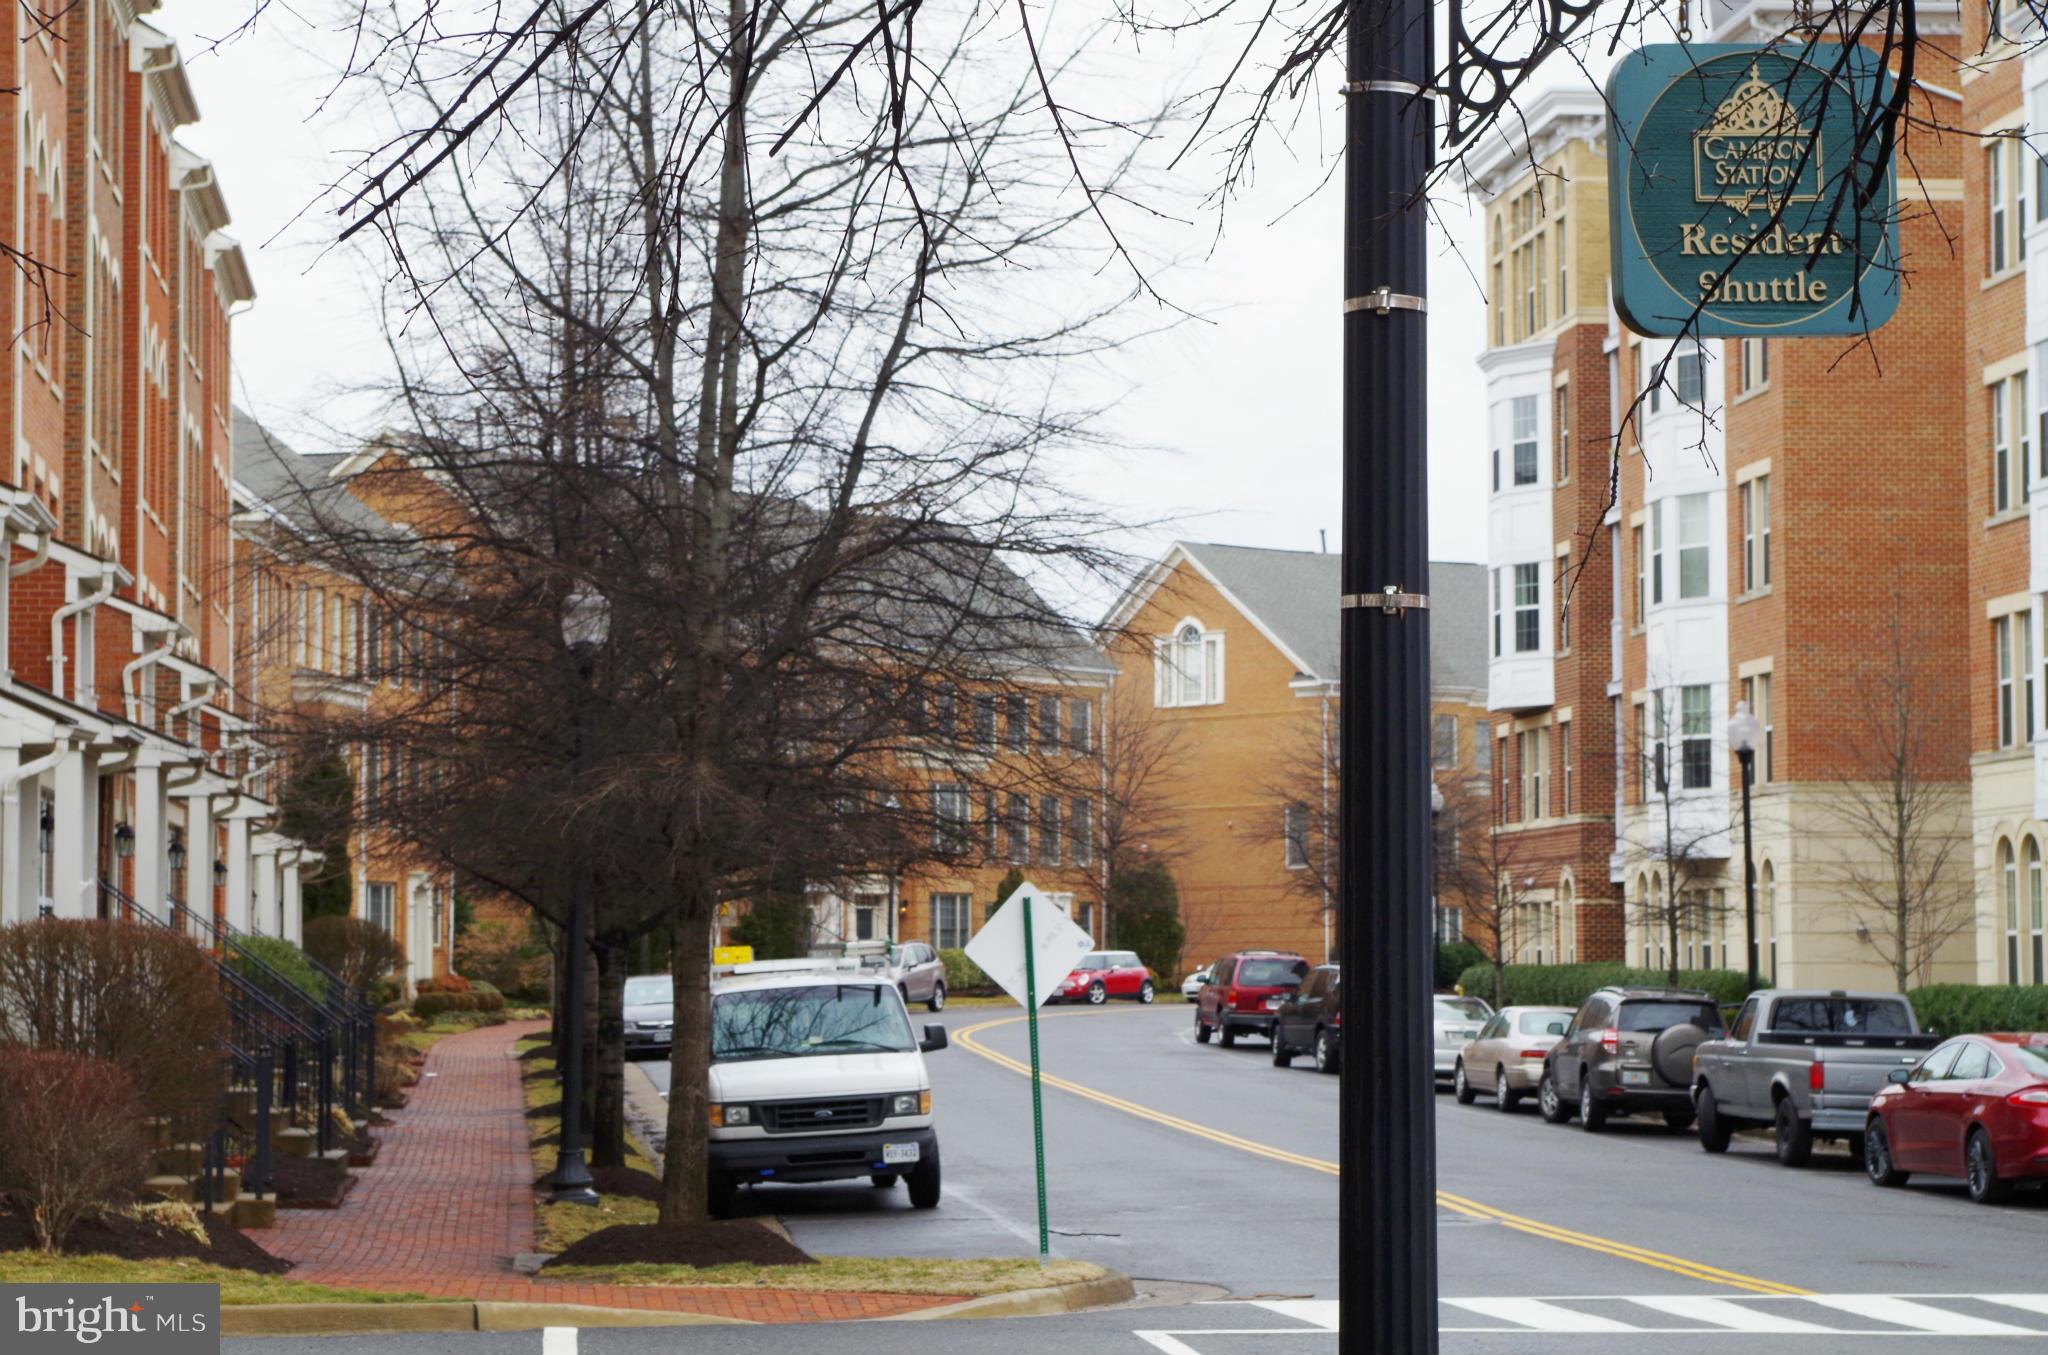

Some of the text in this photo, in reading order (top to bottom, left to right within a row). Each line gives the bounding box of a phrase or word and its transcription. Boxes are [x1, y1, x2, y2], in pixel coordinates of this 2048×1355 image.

[1704, 137, 1811, 160] CAMERON
[1715, 161, 1801, 185] STATION
[1679, 223, 1843, 256] Resident
[1698, 270, 1828, 303] Shuttle
